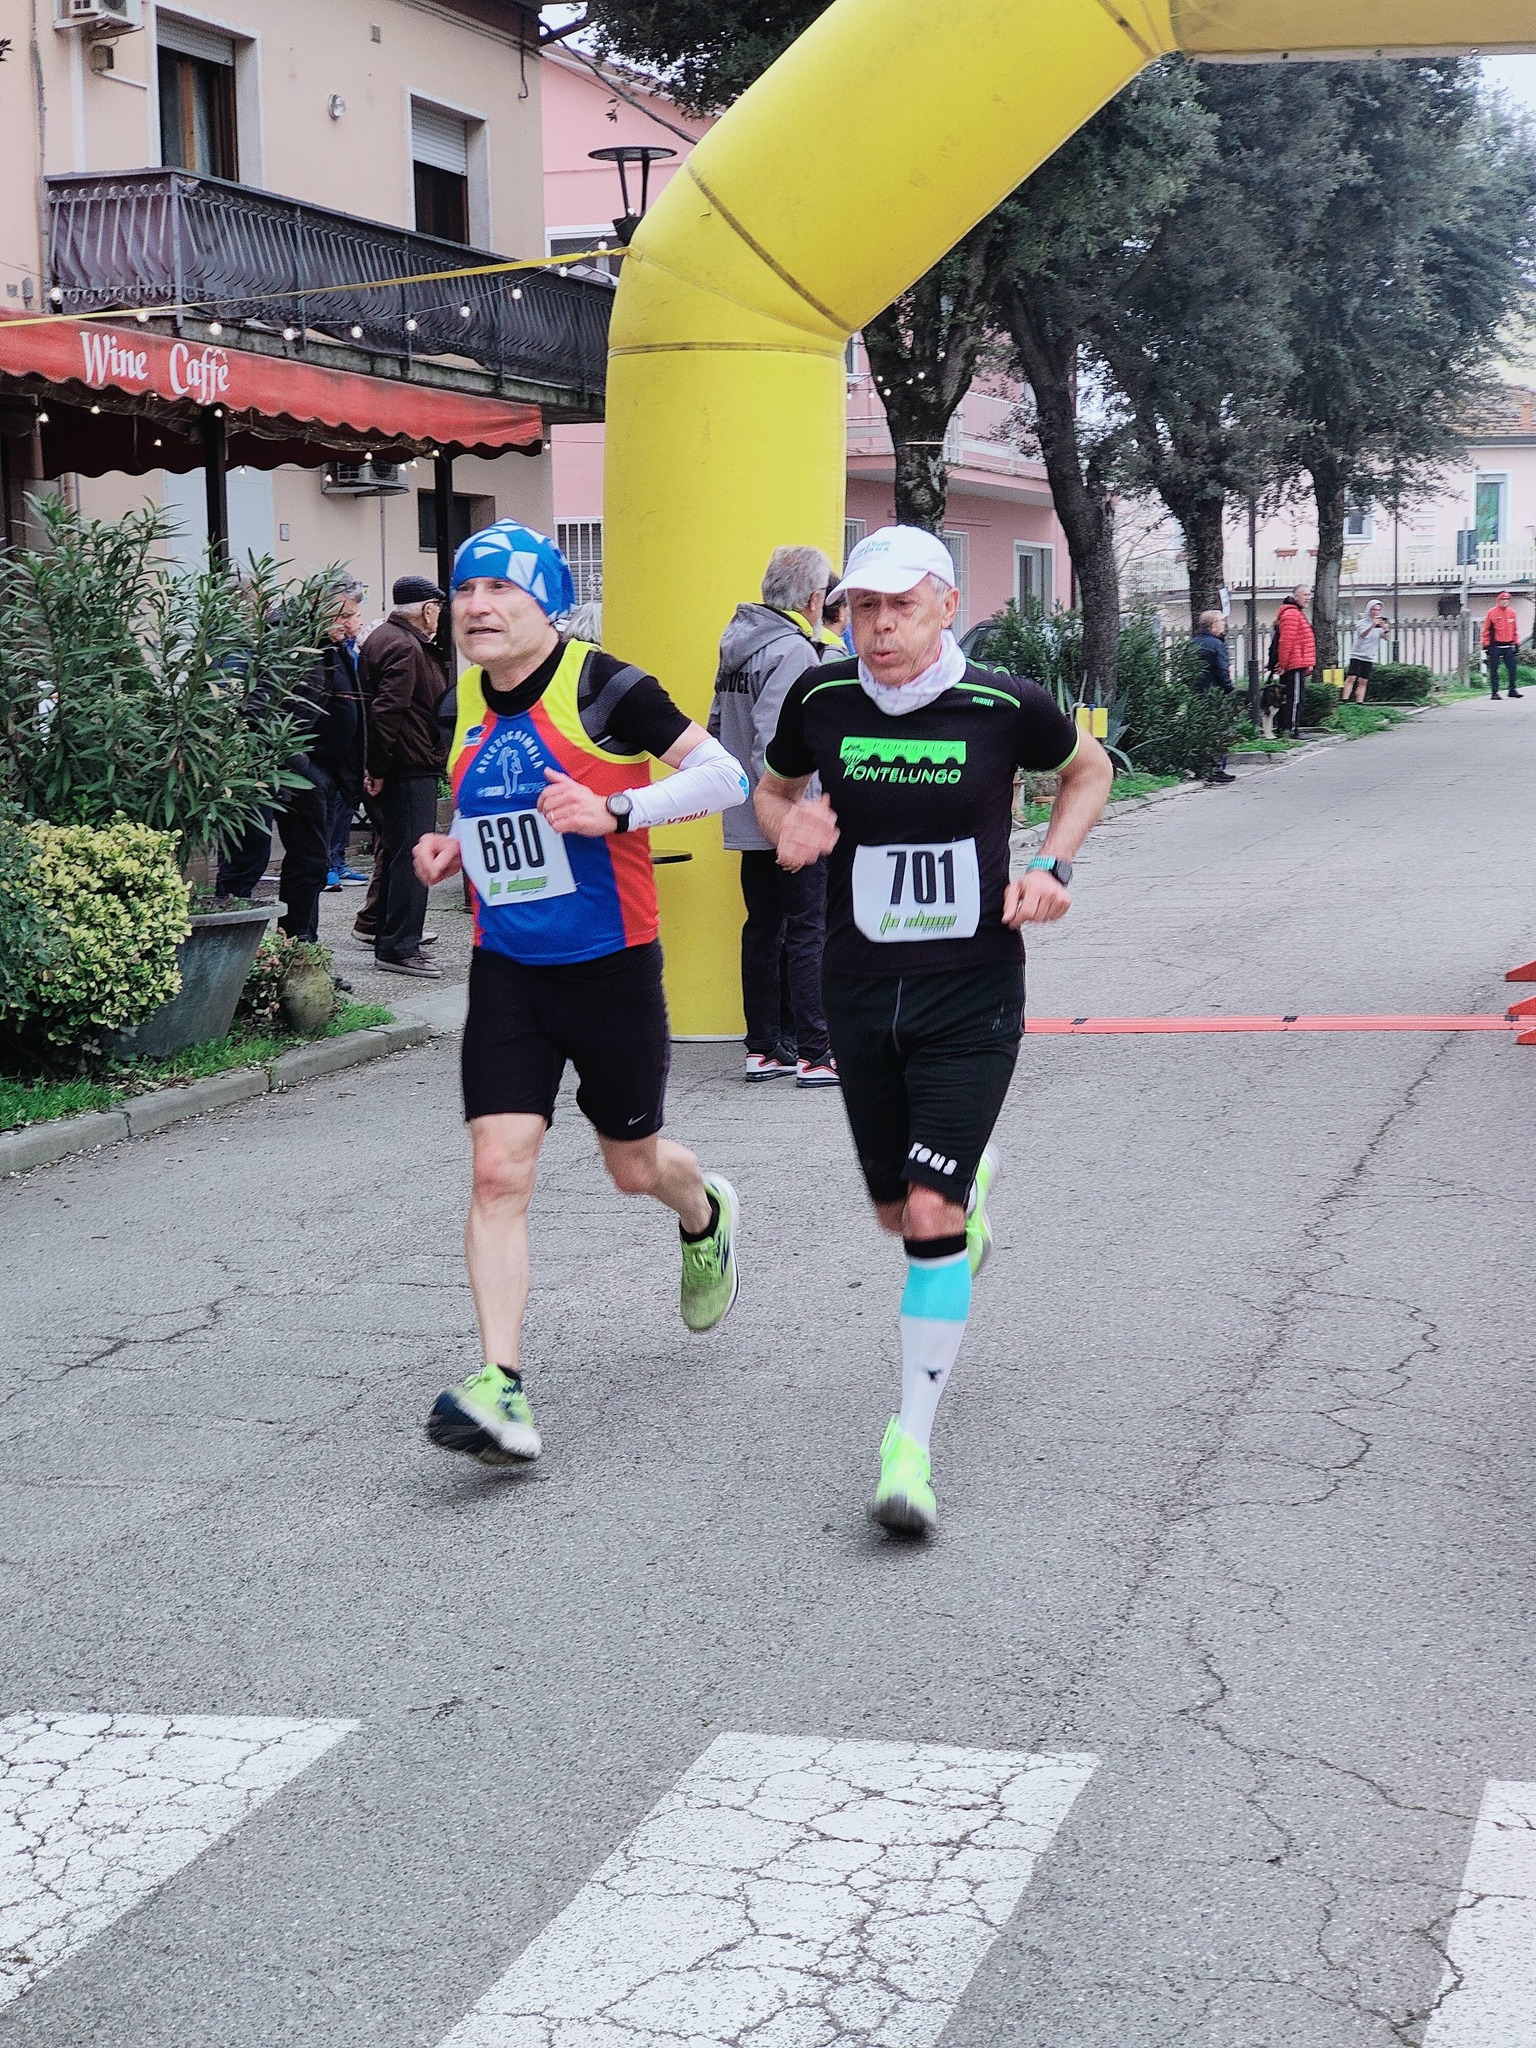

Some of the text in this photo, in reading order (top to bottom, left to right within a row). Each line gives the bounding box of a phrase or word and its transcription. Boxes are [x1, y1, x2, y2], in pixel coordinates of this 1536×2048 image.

[79, 331, 230, 406] Wine Caffè
[842, 765, 962, 785] PONTELUNGO
[477, 813, 545, 873] 680
[886, 849, 956, 905] 701
